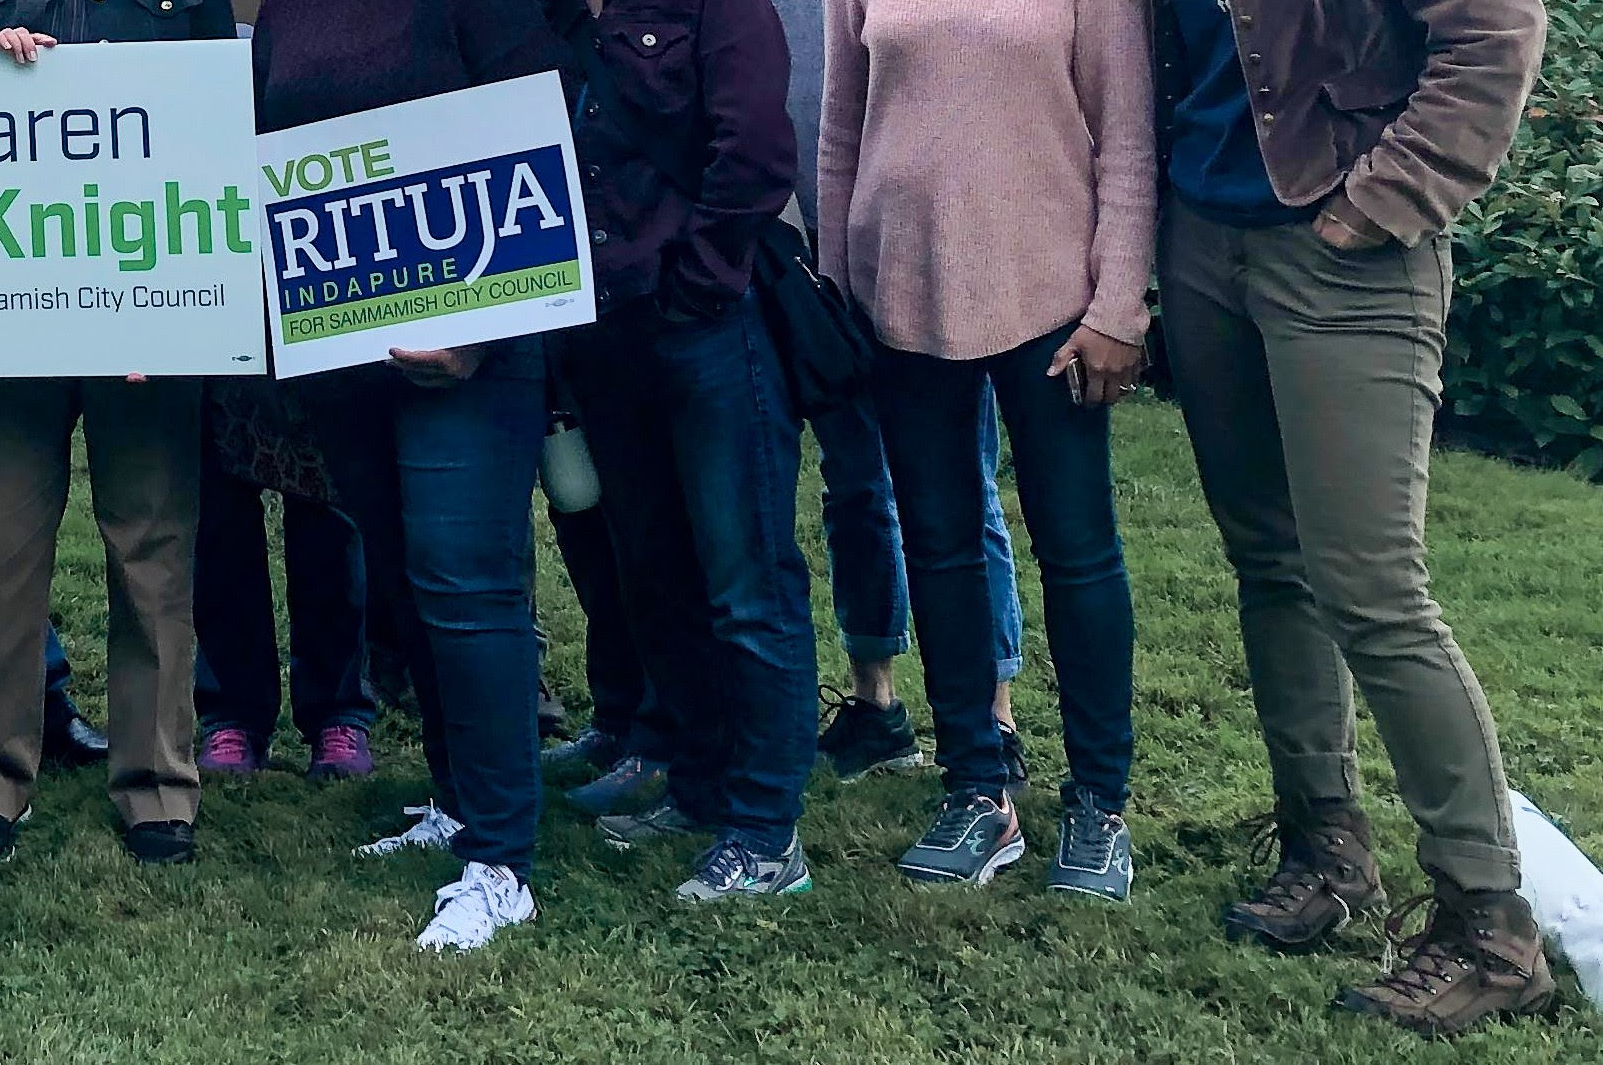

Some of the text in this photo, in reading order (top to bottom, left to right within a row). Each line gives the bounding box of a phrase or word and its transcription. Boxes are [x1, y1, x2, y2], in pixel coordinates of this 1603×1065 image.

[261, 138, 395, 198] VOTE
[273, 161, 565, 286] RITUJA
[78, 286, 124, 313] City
[133, 284, 226, 308] Council
[284, 257, 458, 309] INDAPURE
[290, 270, 573, 337] FOR SAMMAMISH CITY COUNCIL
